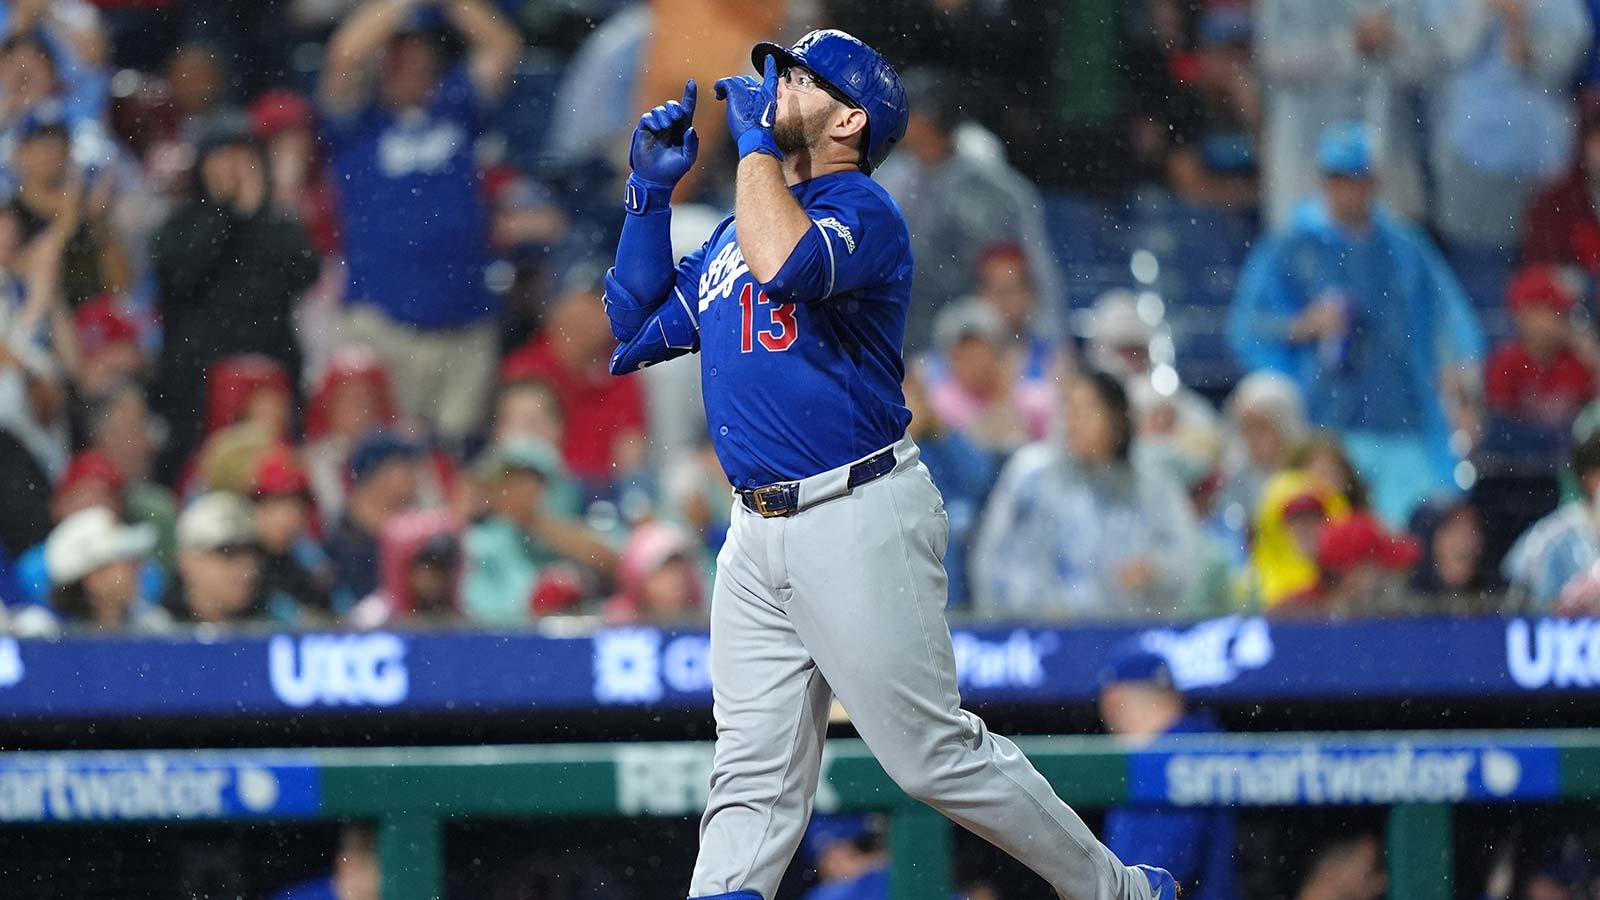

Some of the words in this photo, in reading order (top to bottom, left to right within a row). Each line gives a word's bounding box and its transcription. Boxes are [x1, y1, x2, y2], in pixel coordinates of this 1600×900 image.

[818, 217, 856, 254] Dodgers
[739, 282, 798, 353] 13
[269, 632, 409, 706] UKG
[1165, 741, 1474, 806] smartwater
